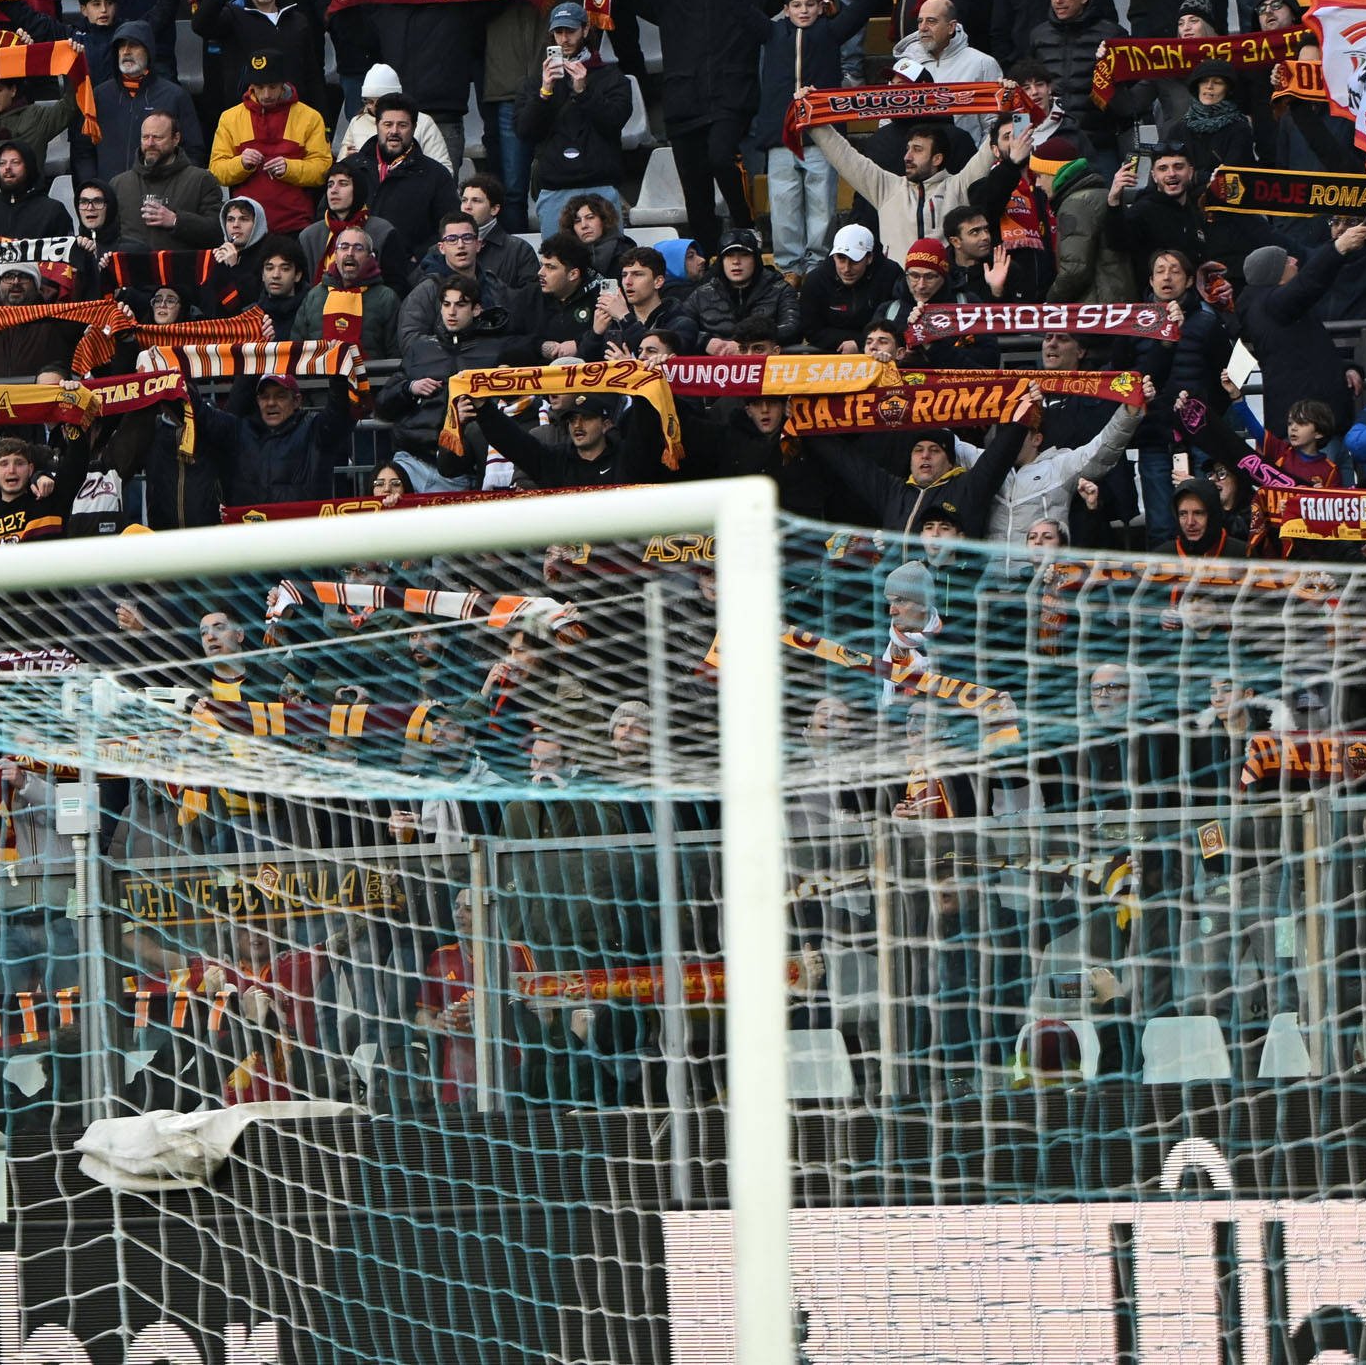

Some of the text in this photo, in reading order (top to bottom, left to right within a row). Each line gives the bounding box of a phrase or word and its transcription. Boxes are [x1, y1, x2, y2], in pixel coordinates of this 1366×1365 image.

[828, 88, 924, 112] roma
[1252, 178, 1305, 205] DAJE
[954, 305, 1069, 332] ROMA
[767, 360, 797, 383] TU
[788, 384, 1003, 430] DAJE ROMA
[1261, 736, 1342, 773] DAJE
[124, 879, 219, 919] CHI VE
